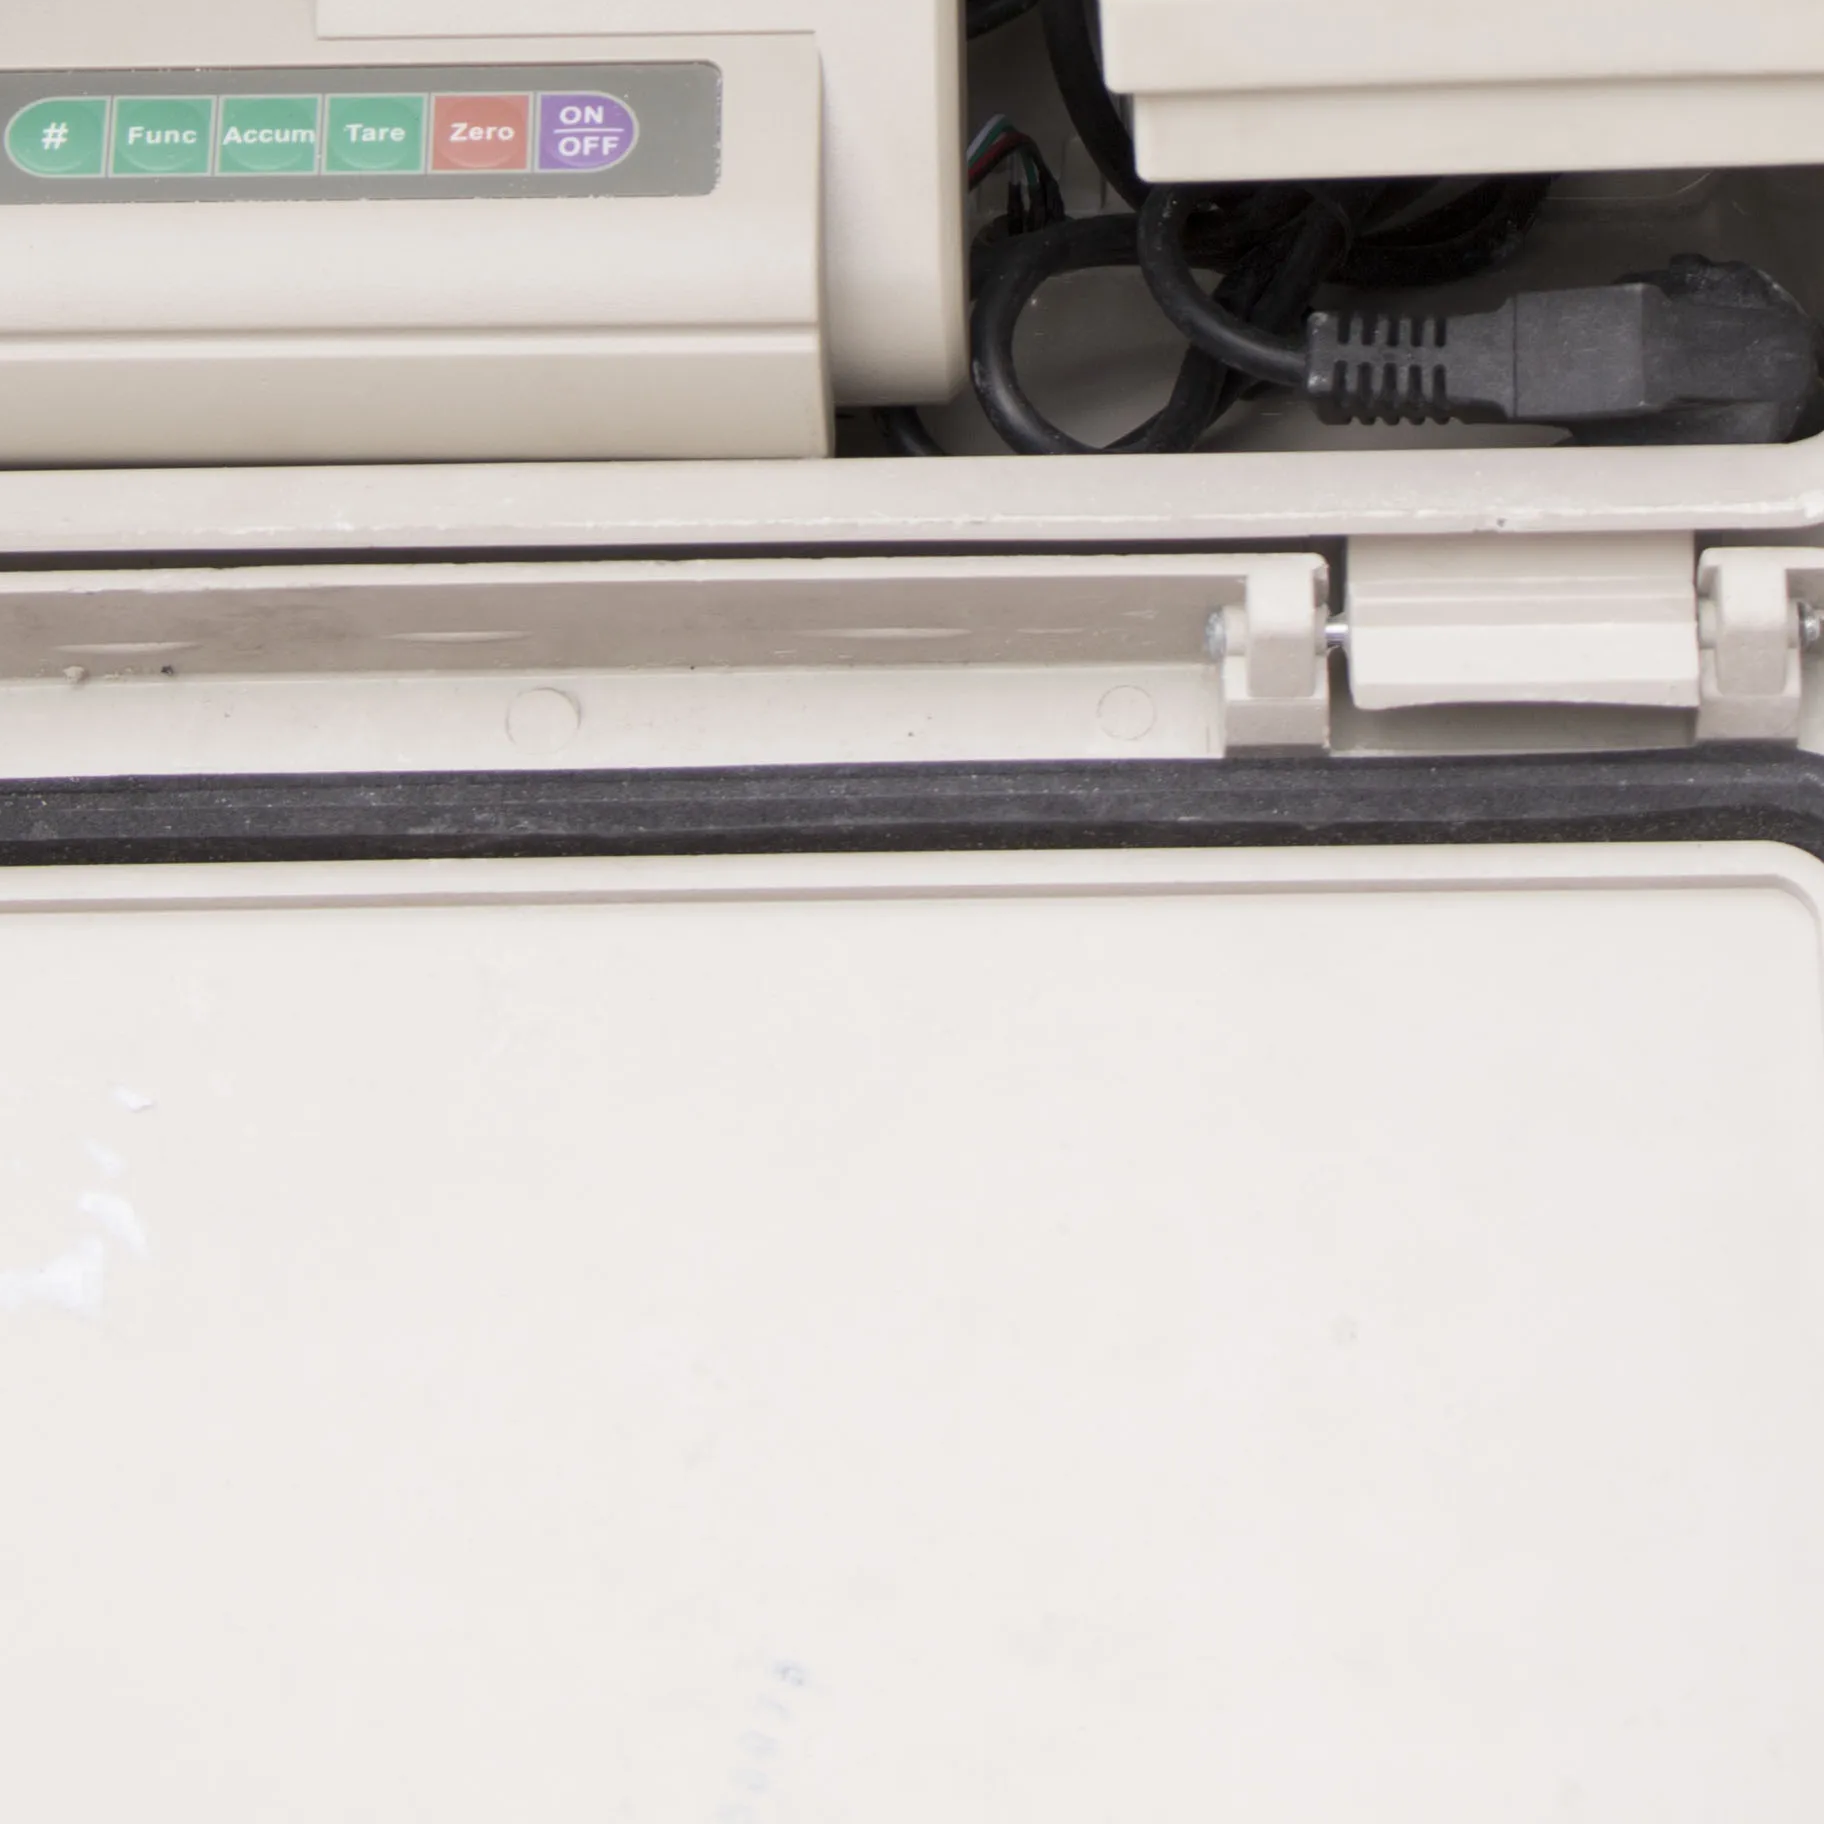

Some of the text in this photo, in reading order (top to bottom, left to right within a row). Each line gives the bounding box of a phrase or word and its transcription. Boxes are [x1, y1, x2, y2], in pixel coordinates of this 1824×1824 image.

[559, 106, 604, 125] ON
[41, 123, 68, 150] #
[127, 127, 197, 145] Func
[223, 126, 314, 144] Accum
[345, 124, 405, 143] Tare
[450, 123, 515, 142] Zero
[558, 137, 619, 157] OFF
